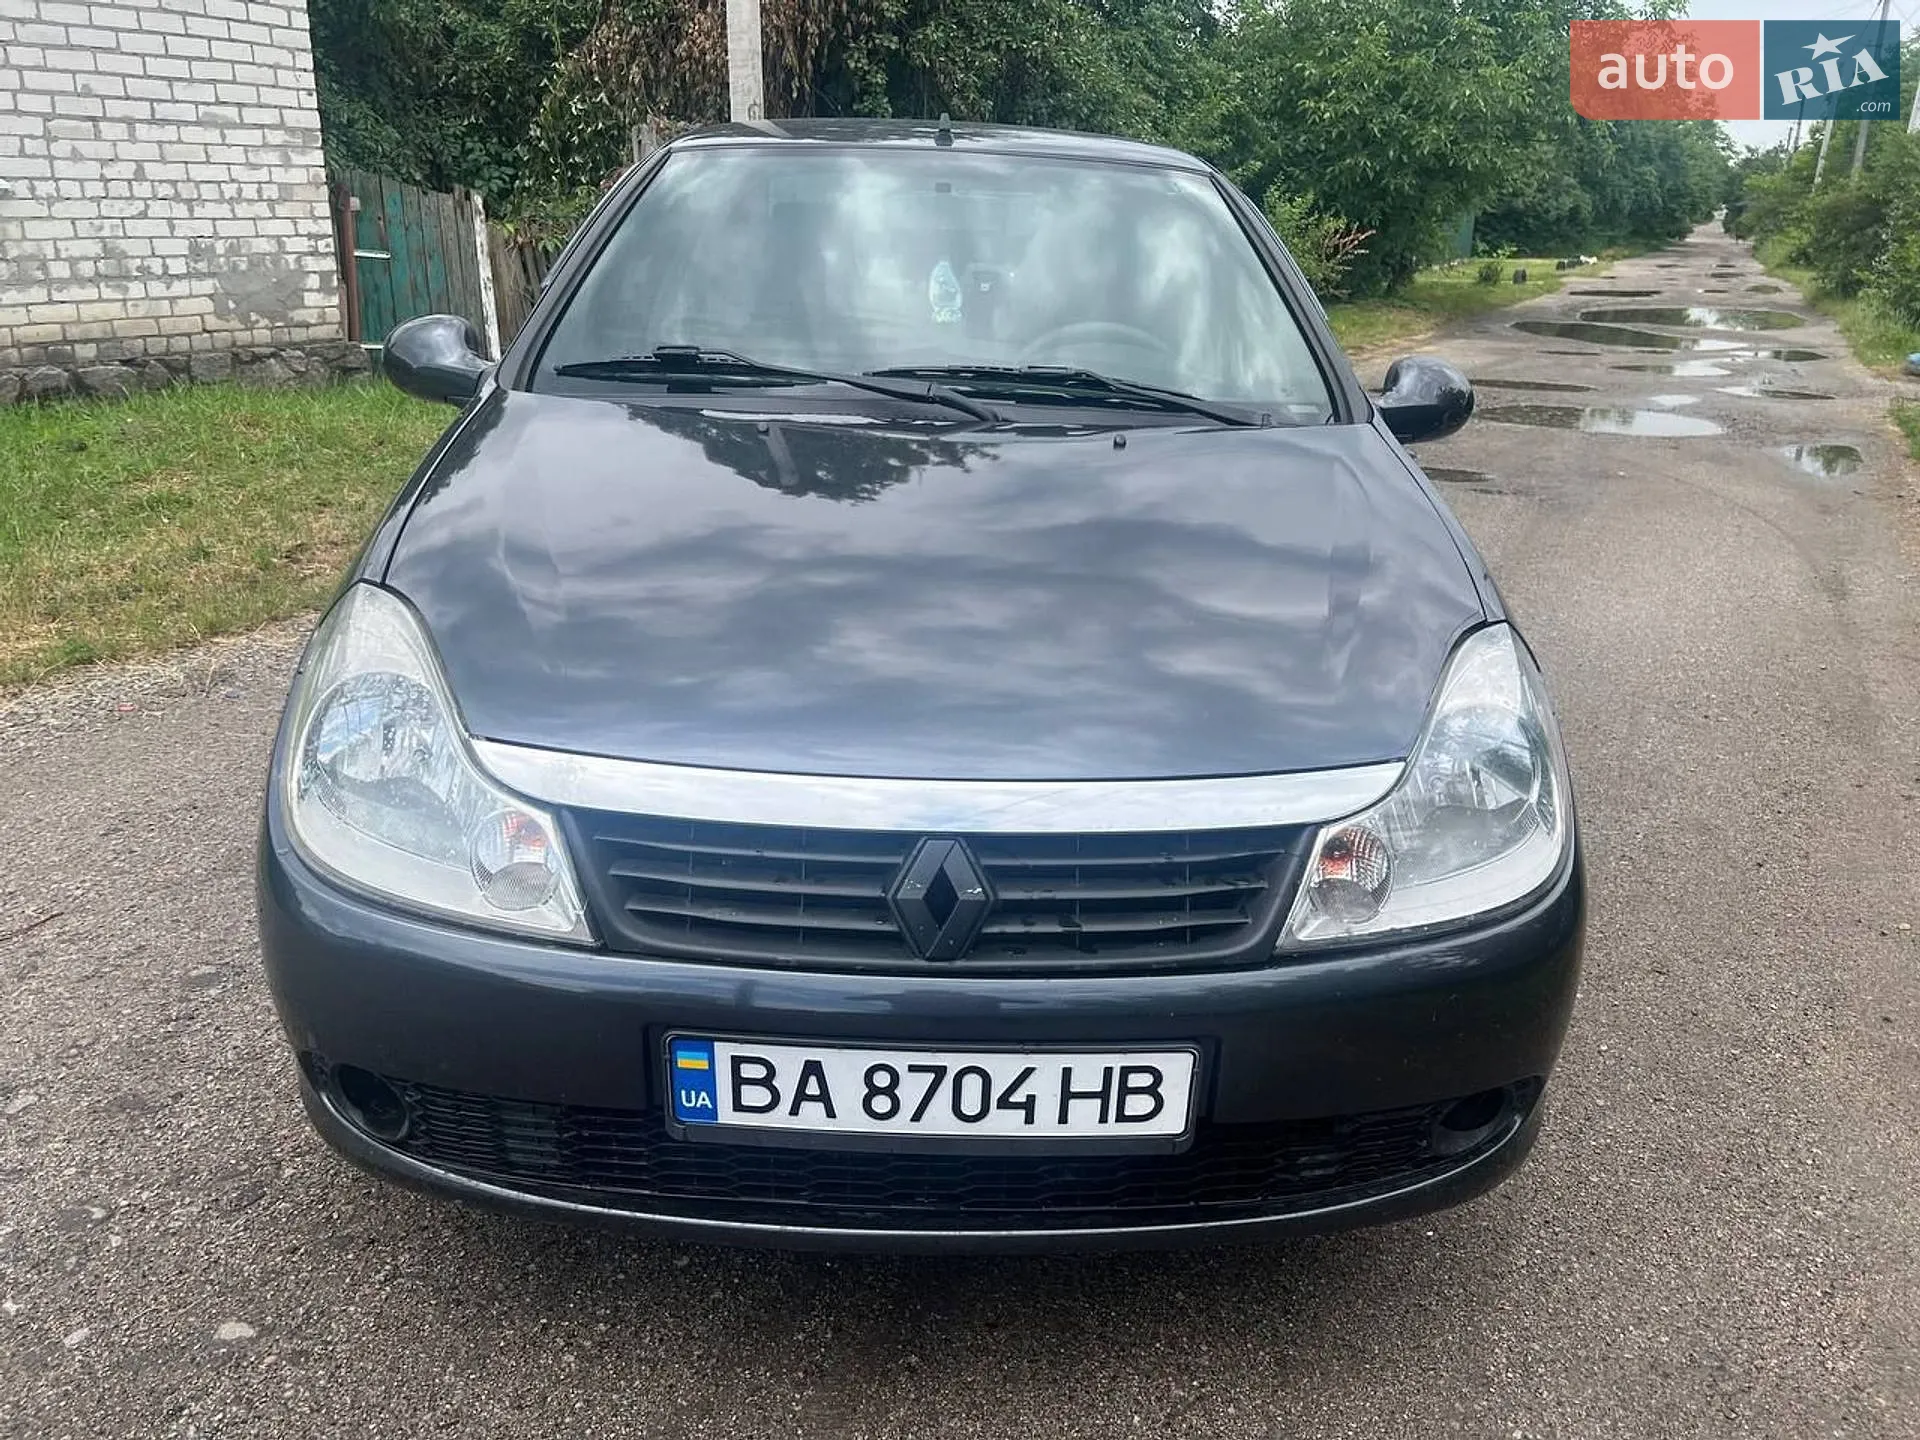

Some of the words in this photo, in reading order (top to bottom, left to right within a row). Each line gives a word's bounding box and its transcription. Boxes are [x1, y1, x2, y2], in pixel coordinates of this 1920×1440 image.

[680, 1089, 713, 1109] UA
[730, 1054, 837, 1120] BA
[861, 1062, 1037, 1126] 8704
[1057, 1063, 1165, 1125] HB
